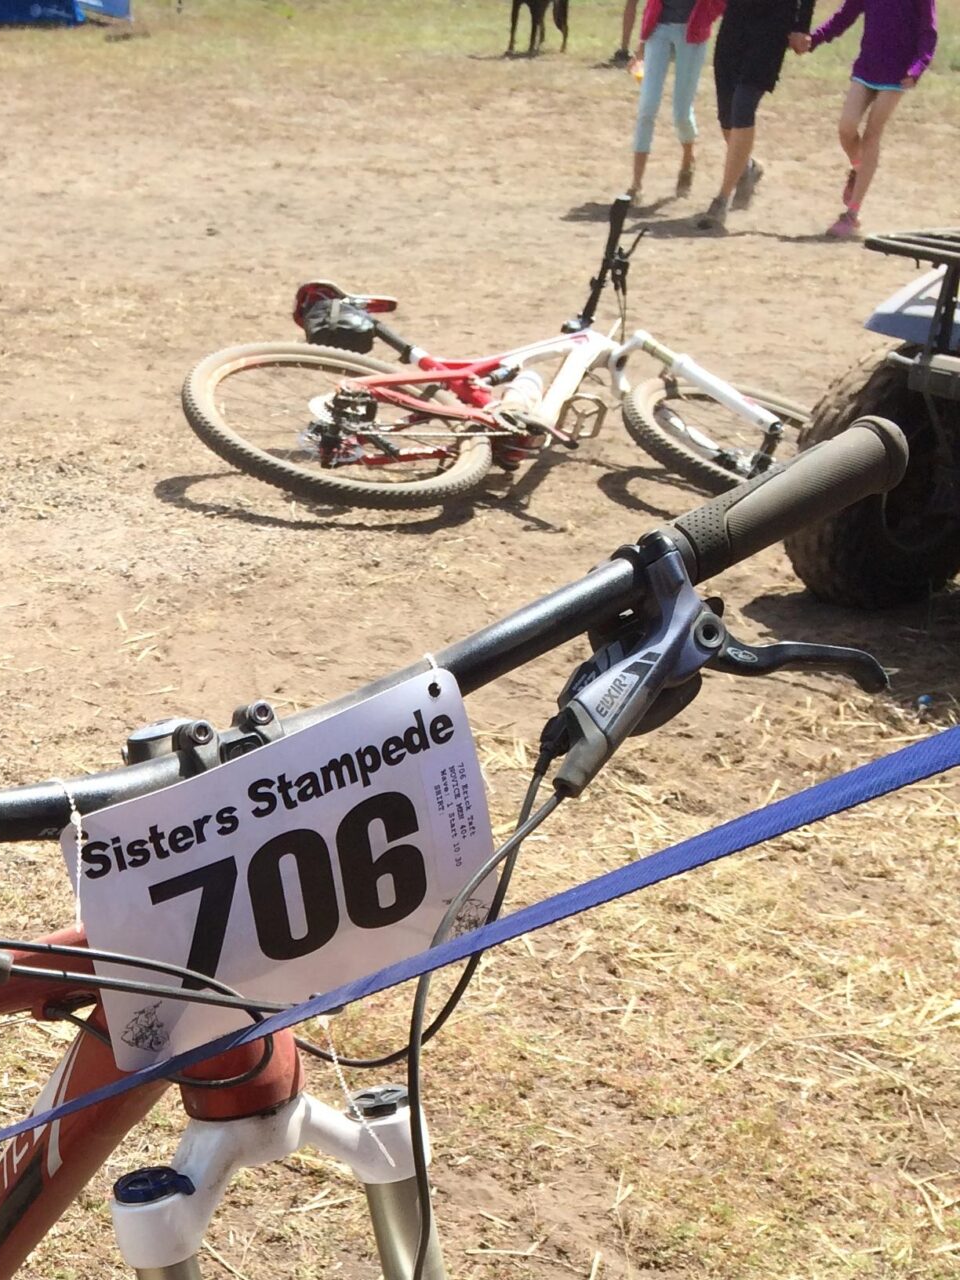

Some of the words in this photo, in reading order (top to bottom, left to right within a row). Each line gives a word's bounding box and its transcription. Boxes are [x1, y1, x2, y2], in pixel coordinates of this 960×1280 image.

[448, 765, 461, 800] NOVICE
[458, 762, 467, 780] 706
[81, 806, 239, 879] Sisters
[247, 709, 455, 818] Stampede
[461, 784, 472, 811] Erick
[448, 812, 458, 839] Start
[148, 791, 427, 991] 706
